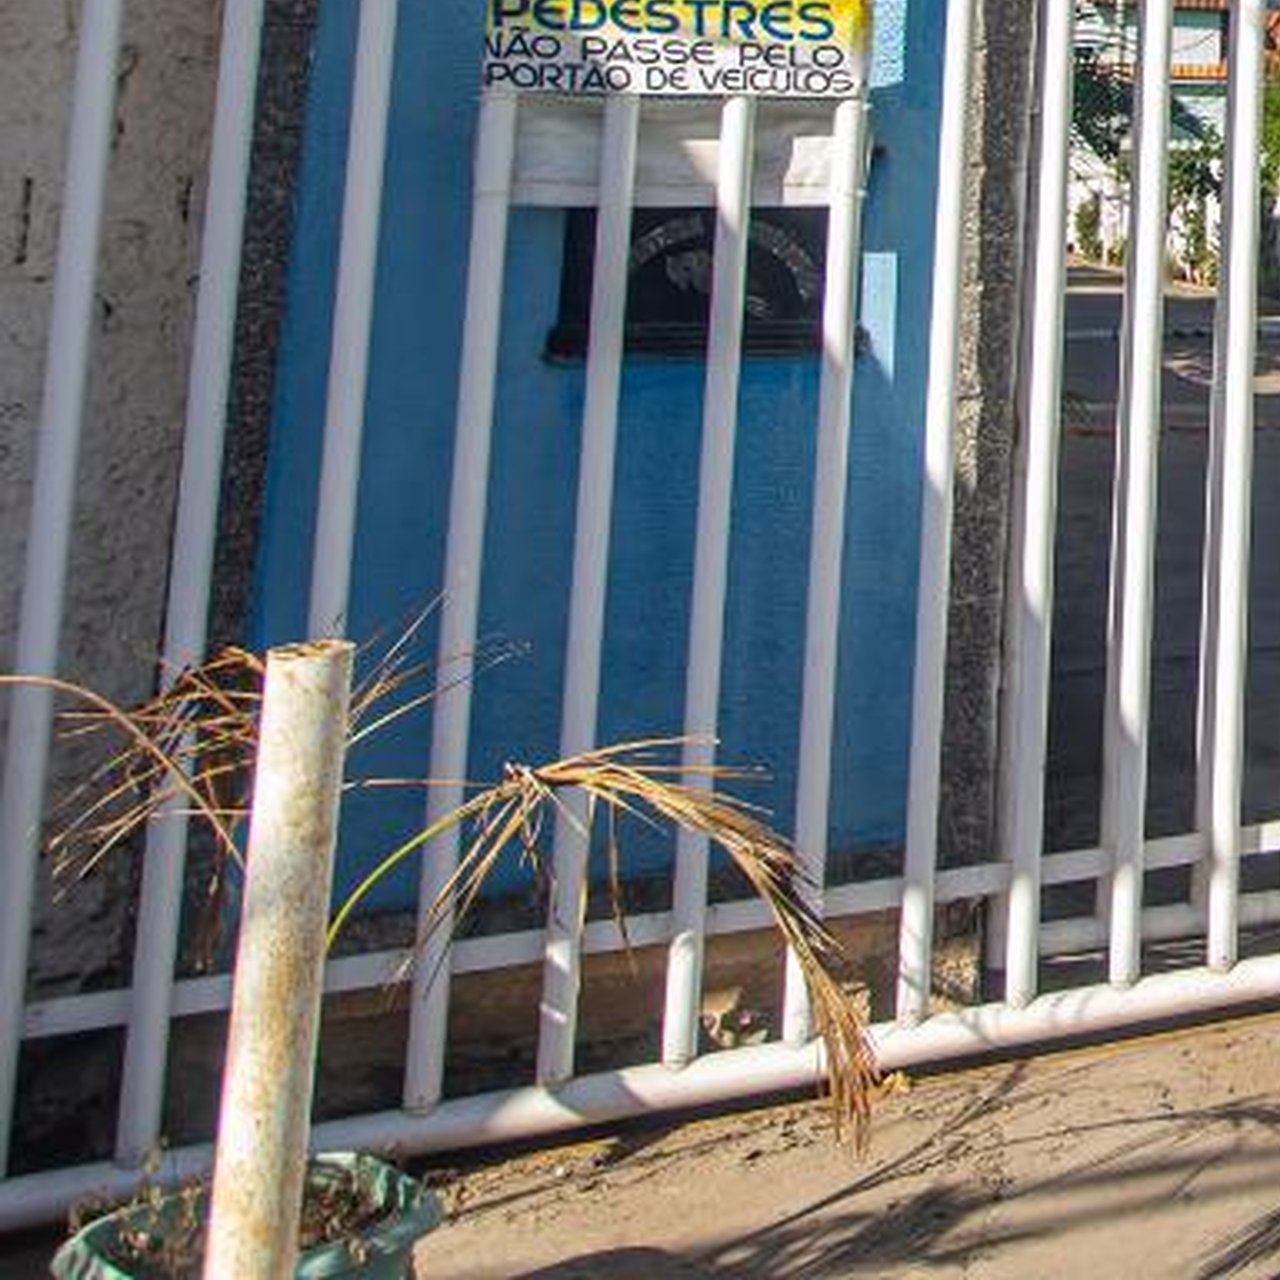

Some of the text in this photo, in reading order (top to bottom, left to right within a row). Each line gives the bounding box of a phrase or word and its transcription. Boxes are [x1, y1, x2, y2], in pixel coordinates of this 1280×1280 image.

[484, 25, 845, 69] NÃO PASSE PELO
[485, 61, 854, 94] PORTÃO DE VEÍCULOS
